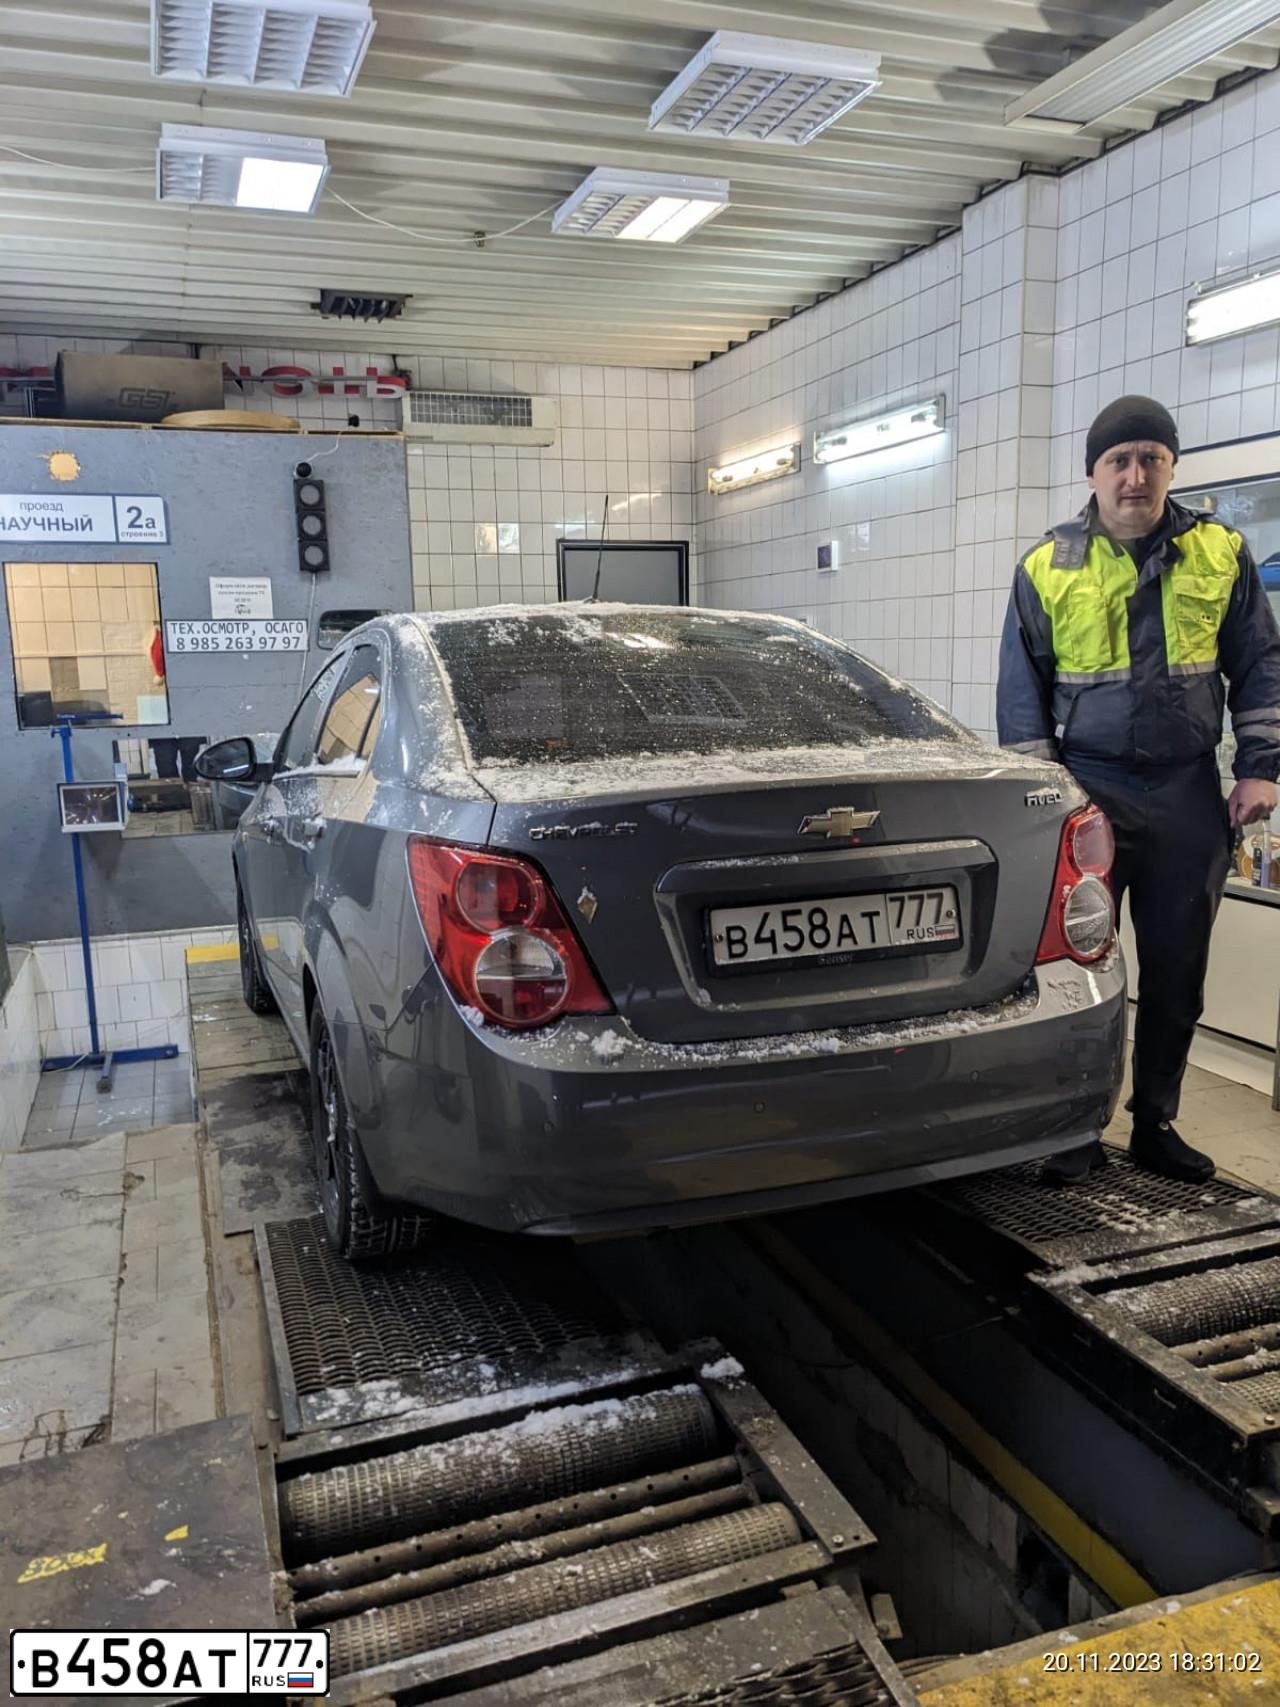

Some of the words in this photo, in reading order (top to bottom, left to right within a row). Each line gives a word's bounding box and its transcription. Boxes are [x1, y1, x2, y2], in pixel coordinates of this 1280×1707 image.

[19, 501, 64, 513] проезд
[126, 506, 156, 529] 2а
[264, 621, 304, 634] ОСАГО
[176, 637, 186, 650] 8
[190, 637, 220, 650] 985
[225, 637, 254, 650] 263
[259, 636, 277, 649] 97
[282, 636, 301, 649] 97
[889, 892, 945, 929] 777
[906, 926, 936, 940] RUS
